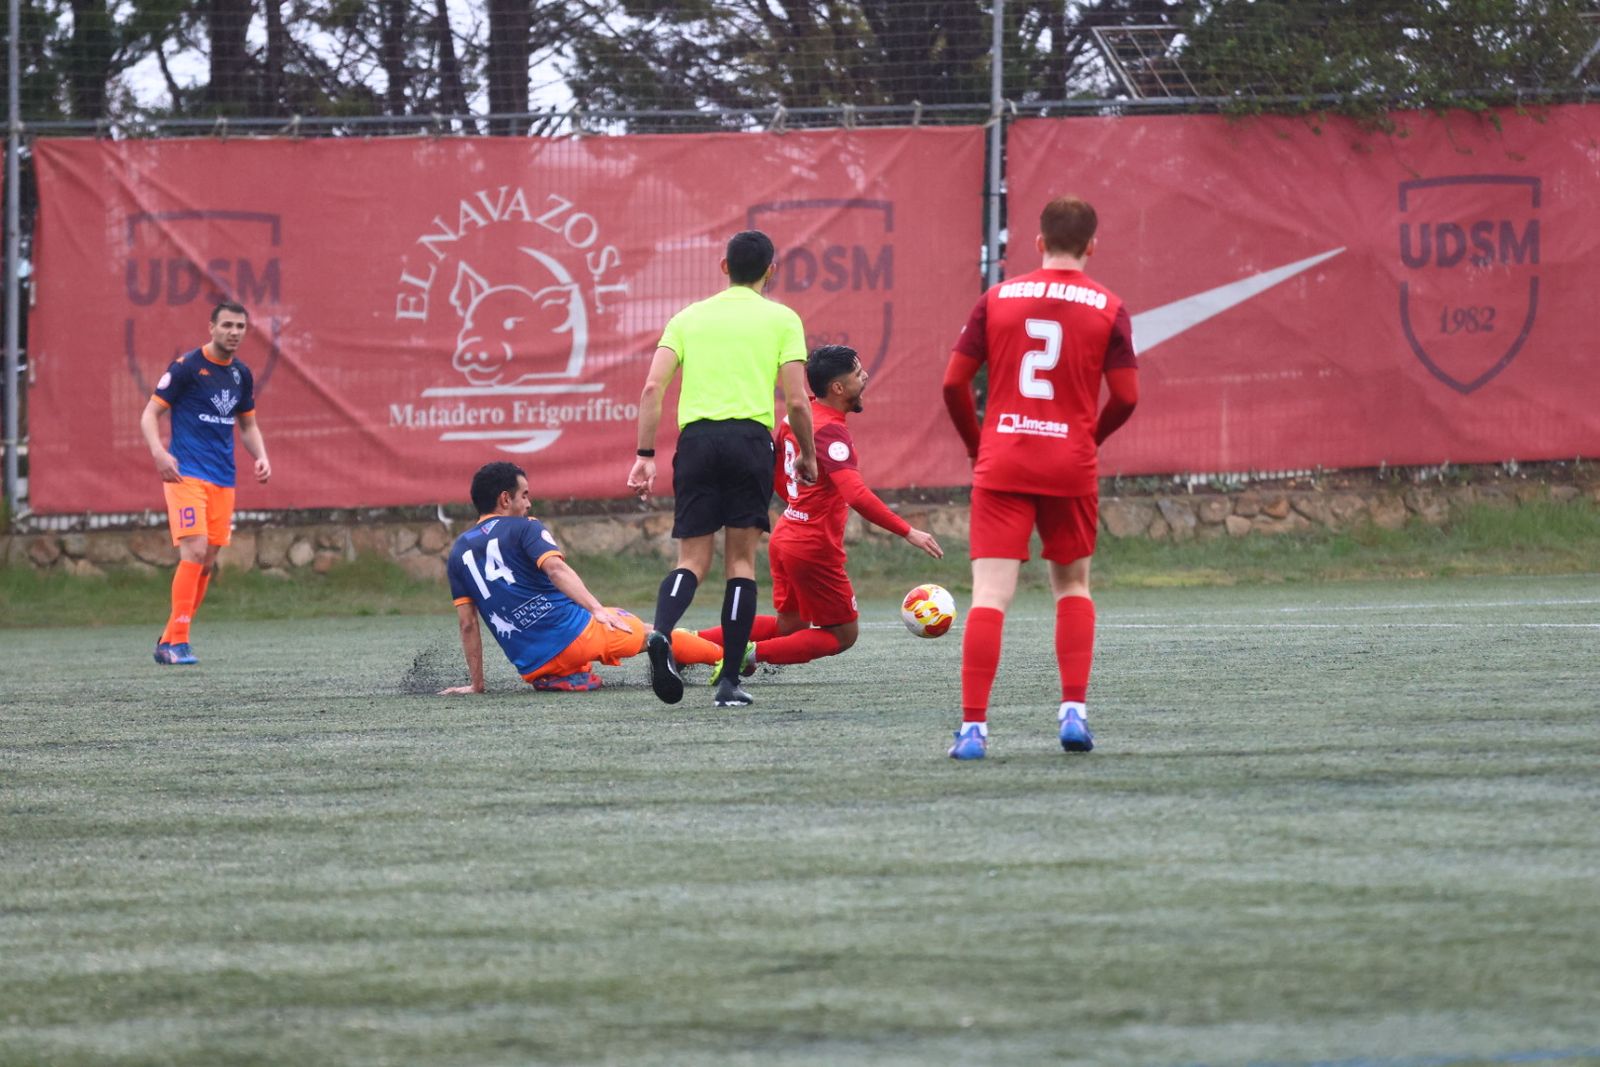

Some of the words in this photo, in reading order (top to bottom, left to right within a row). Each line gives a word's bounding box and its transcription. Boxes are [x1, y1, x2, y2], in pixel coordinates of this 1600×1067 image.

[396, 262, 437, 322] EL
[417, 186, 598, 261] NAVAZO
[1400, 219, 1541, 269] UDSM
[126, 258, 281, 307] UDSM
[998, 281, 1046, 299] DIEGO
[1046, 282, 1107, 310] ALONSO
[1440, 305, 1496, 335] 1982
[1019, 318, 1064, 400] 2
[389, 404, 504, 428] Matadero
[512, 399, 638, 427] Frigorífico
[179, 507, 196, 528] 19
[462, 538, 517, 600] 14
